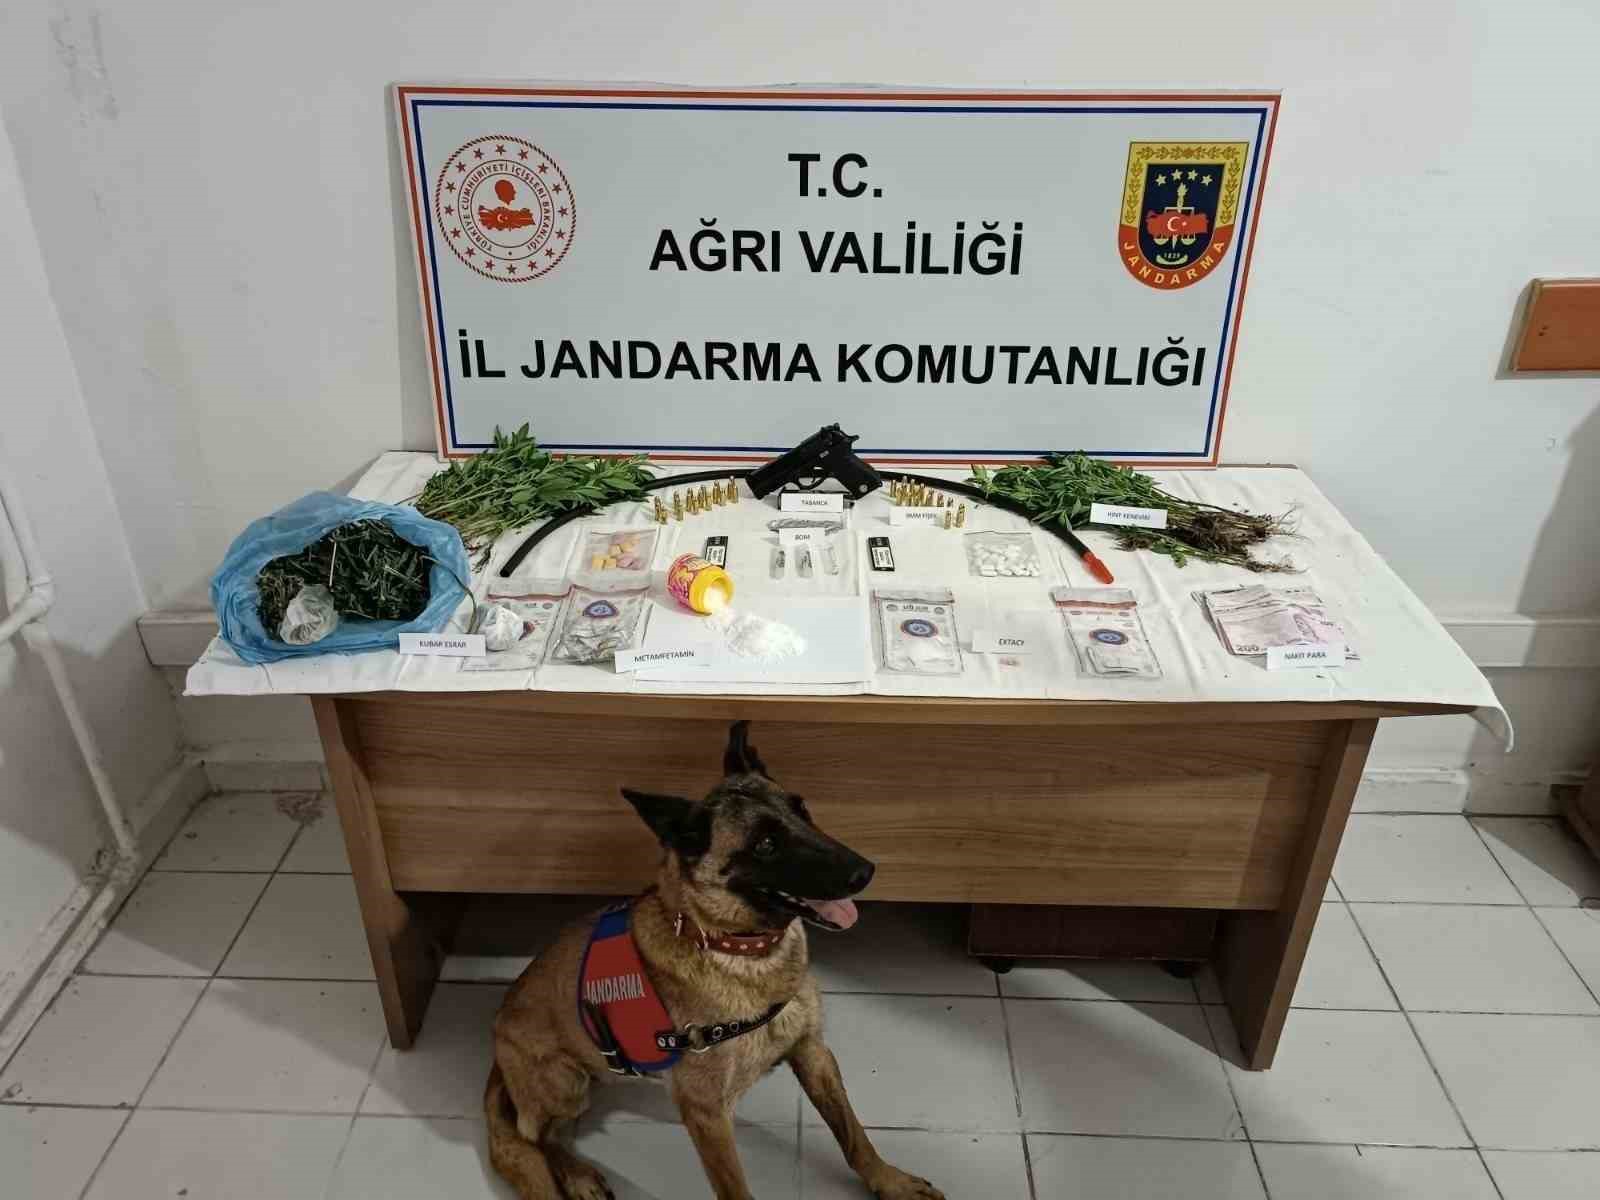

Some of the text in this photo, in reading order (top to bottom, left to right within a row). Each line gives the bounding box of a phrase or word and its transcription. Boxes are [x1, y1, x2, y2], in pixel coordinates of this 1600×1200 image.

[461, 161, 509, 211] CUMHURİYETİ
[787, 153, 882, 198] T.C.
[649, 217, 1023, 276] AĞRI VALİLİĞİ
[1124, 241, 1225, 284] JANDARMA
[458, 328, 1206, 387] İL JANDARMA KOMUTANLIĞI
[584, 973, 646, 1005] JANDARMA
